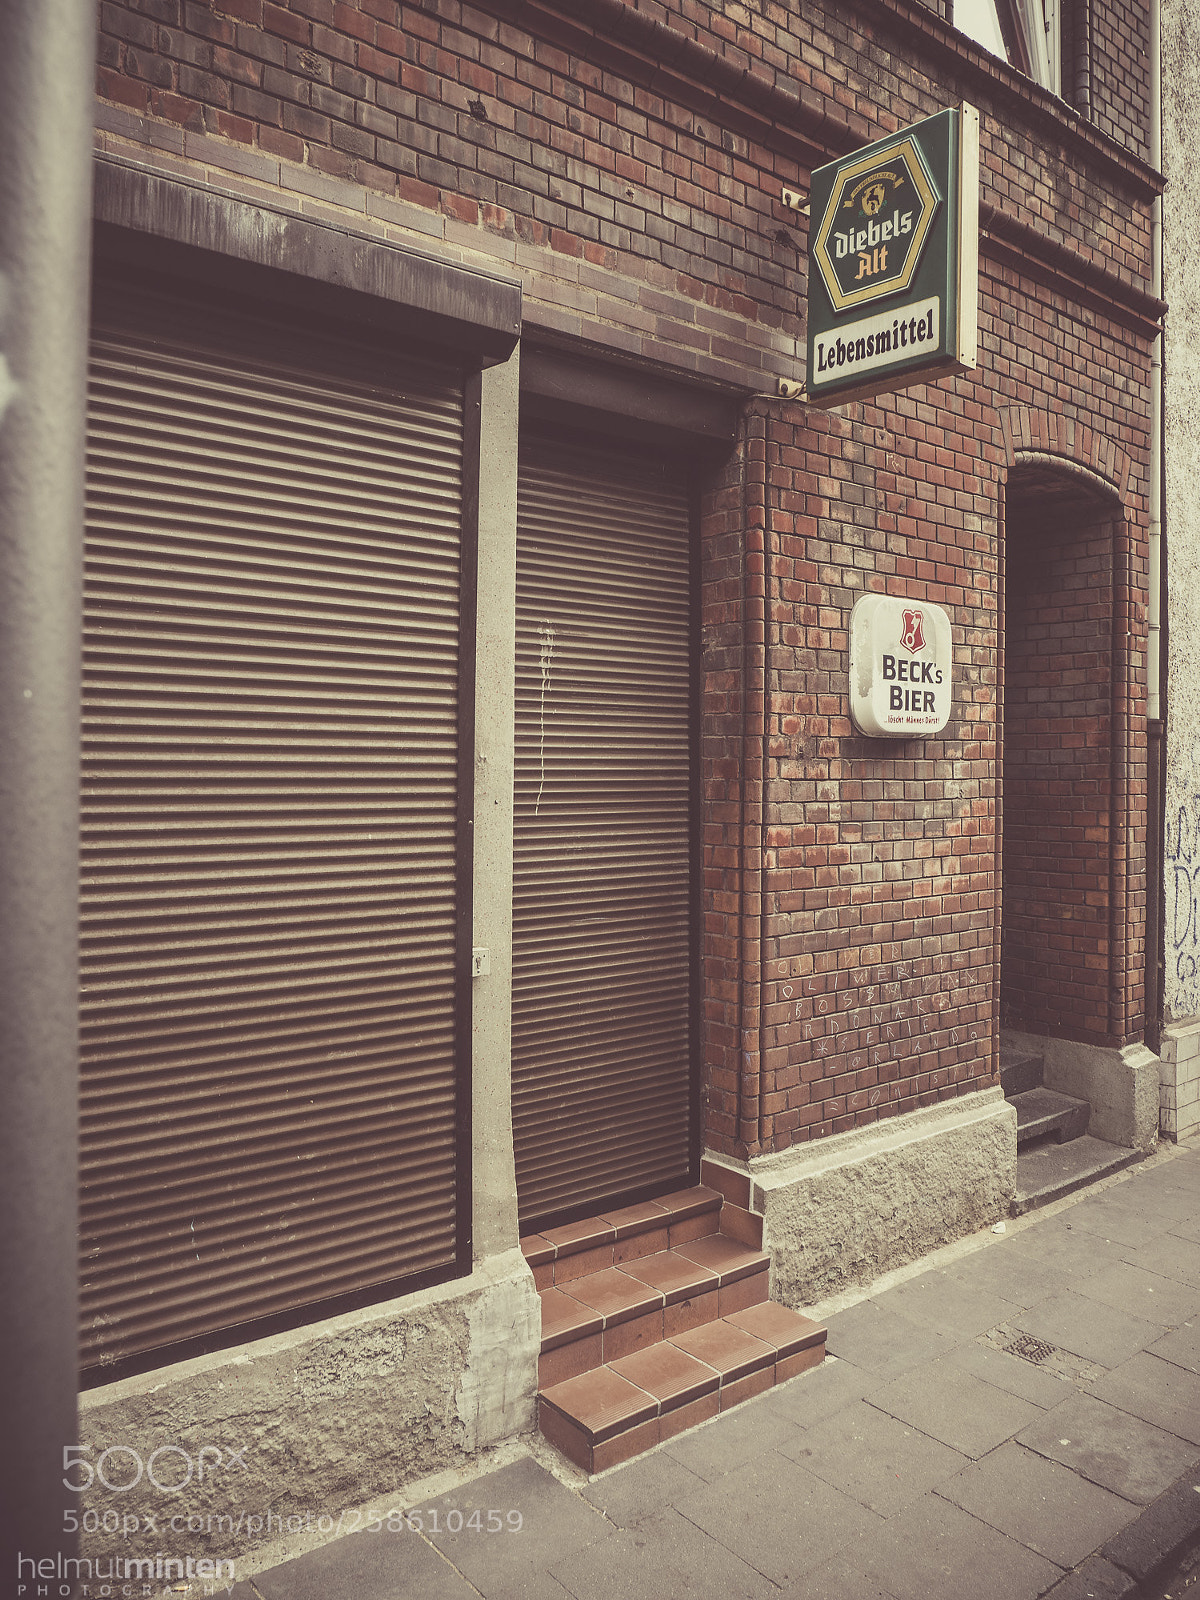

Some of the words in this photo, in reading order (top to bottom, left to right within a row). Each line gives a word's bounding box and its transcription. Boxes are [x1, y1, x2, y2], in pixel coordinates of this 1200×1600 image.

[854, 244, 889, 280] Alt
[817, 308, 934, 372] Lebensmittel
[889, 685, 936, 713] BIER
